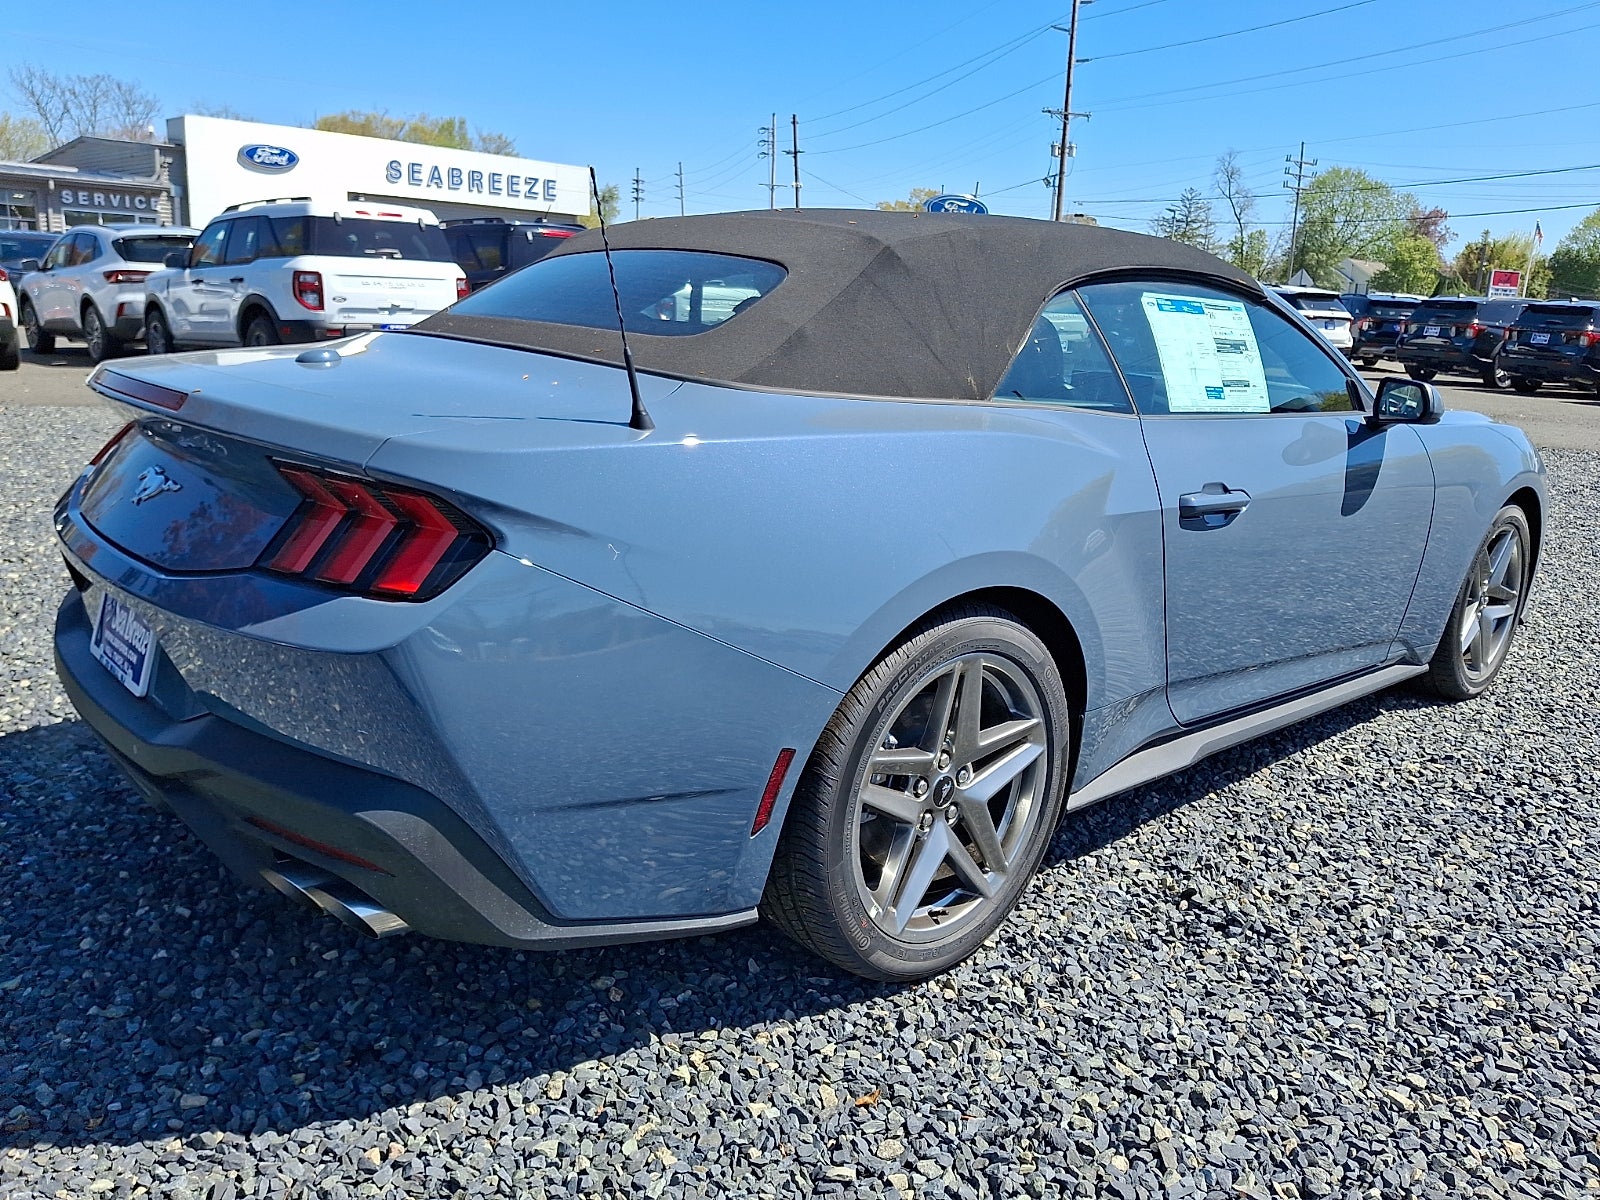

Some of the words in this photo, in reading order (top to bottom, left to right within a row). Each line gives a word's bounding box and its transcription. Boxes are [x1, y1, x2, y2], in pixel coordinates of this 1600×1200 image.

[253, 147, 290, 166] Ford
[386, 160, 557, 201] SEABREEZE
[61, 189, 160, 211] SERVICE
